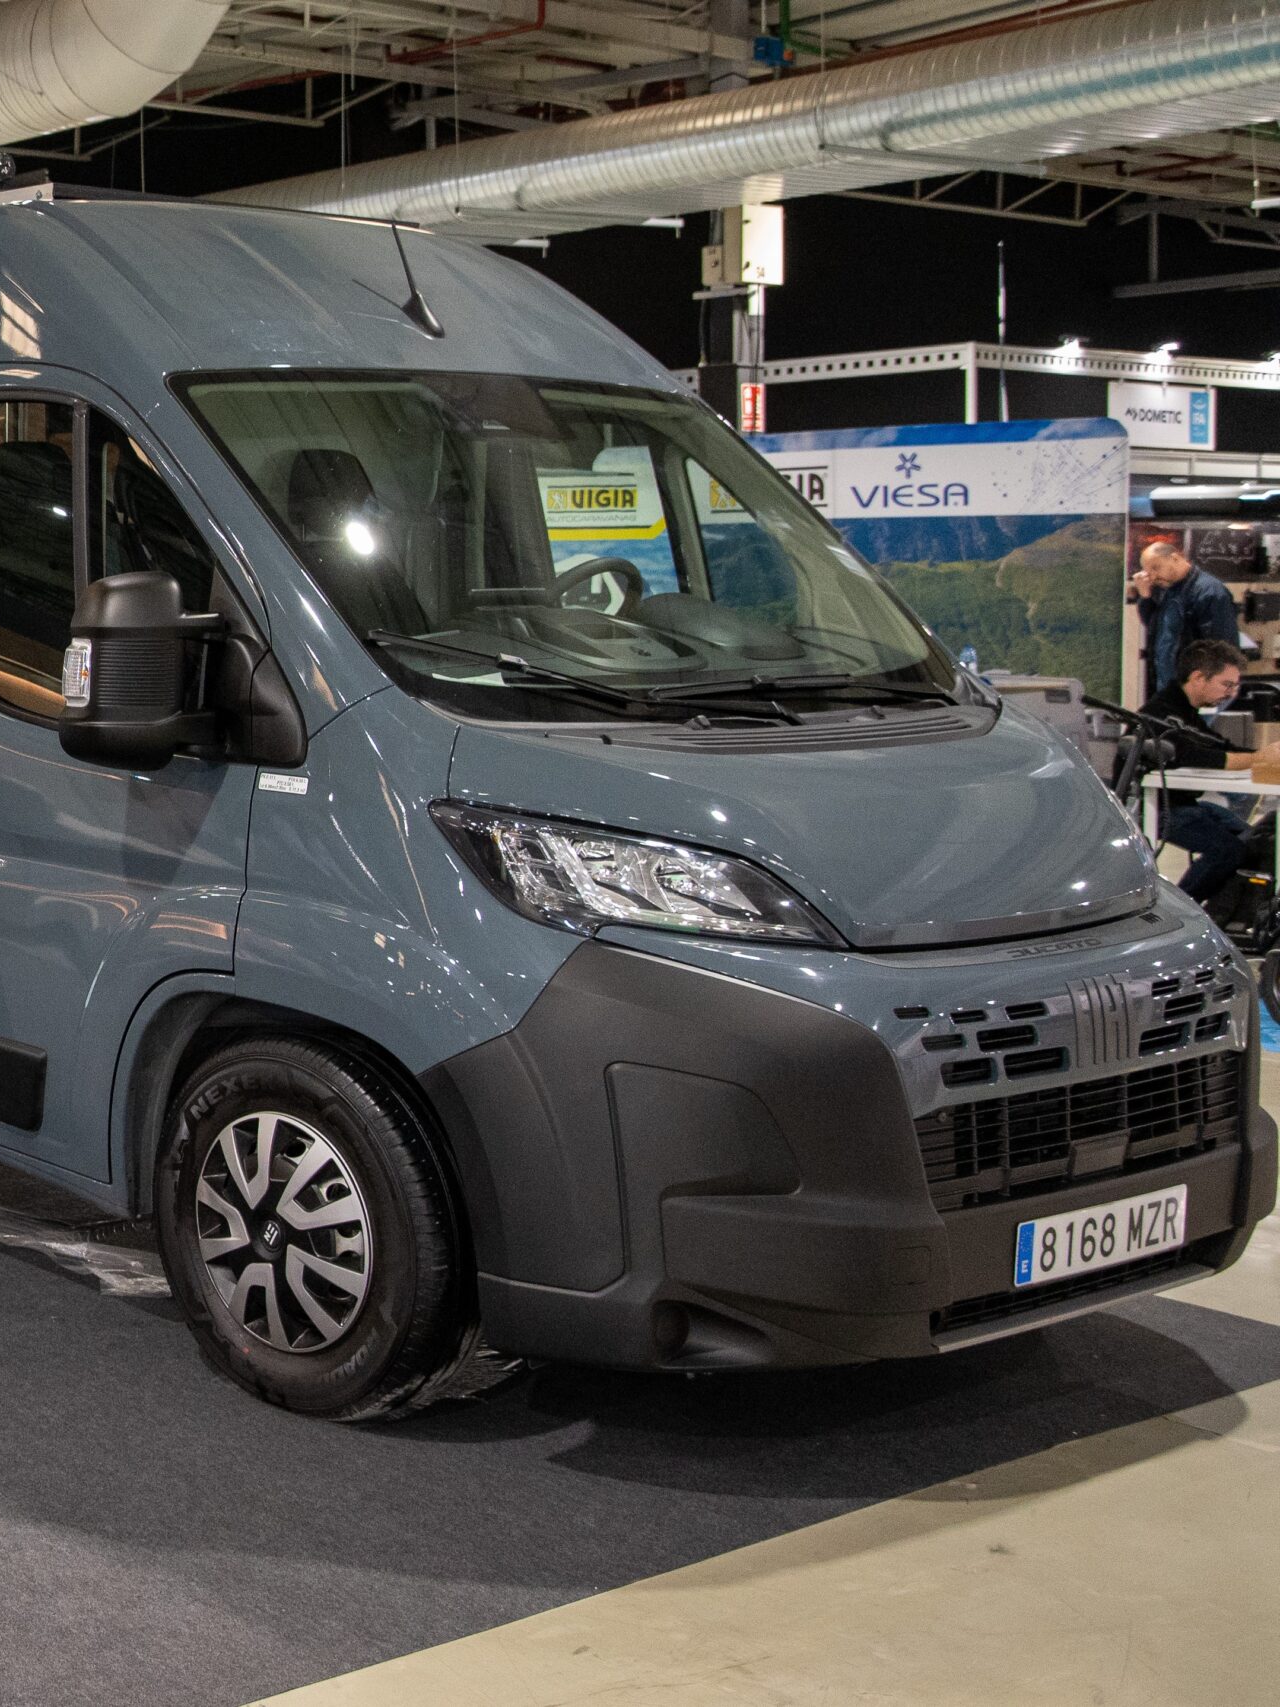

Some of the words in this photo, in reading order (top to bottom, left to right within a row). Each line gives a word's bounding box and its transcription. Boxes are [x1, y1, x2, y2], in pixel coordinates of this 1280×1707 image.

[1140, 408, 1182, 424] DOMETIC
[850, 483, 969, 509] VIESA
[1006, 938, 1103, 958] DUCATO
[189, 1074, 276, 1121] NEXE
[1039, 1212, 1116, 1273] 8168
[1127, 1196, 1179, 1252] MZR
[1021, 1259, 1029, 1274] E
